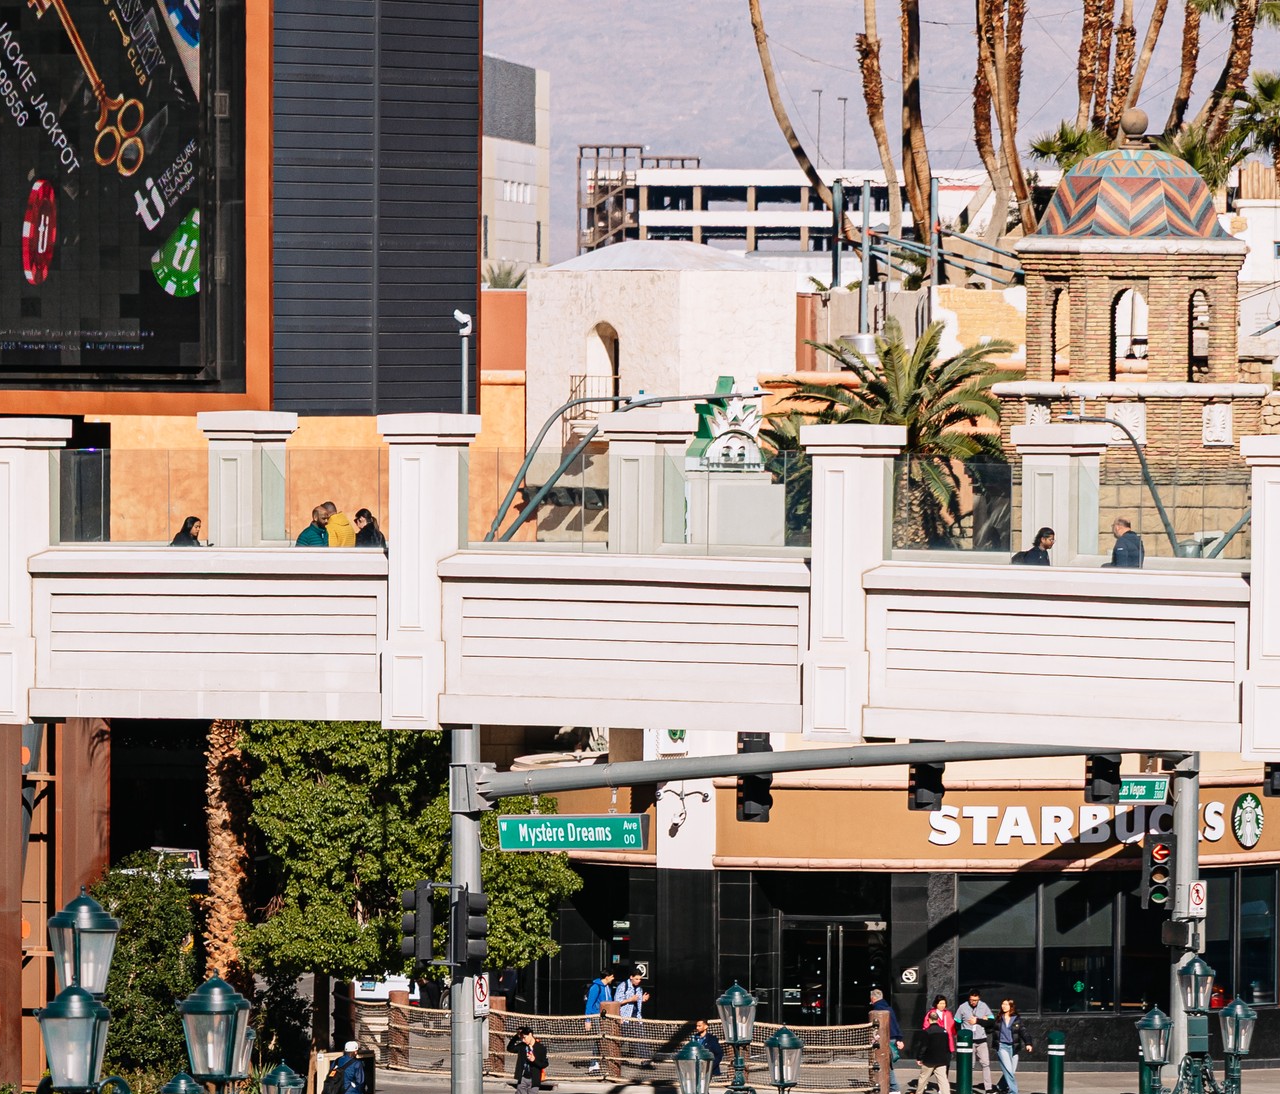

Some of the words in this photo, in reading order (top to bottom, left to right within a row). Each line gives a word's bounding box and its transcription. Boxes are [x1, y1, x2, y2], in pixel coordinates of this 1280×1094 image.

[127, 49, 147, 86] CLUB
[31, 92, 80, 174] JACKPOT
[1130, 782, 1147, 799] Vegas
[501, 822, 507, 831] W
[519, 822, 565, 846] Mystère
[567, 823, 612, 842] Dreams
[623, 820, 637, 830] Ave
[624, 834, 635, 844] 00
[928, 802, 1225, 845] STARBUCS
